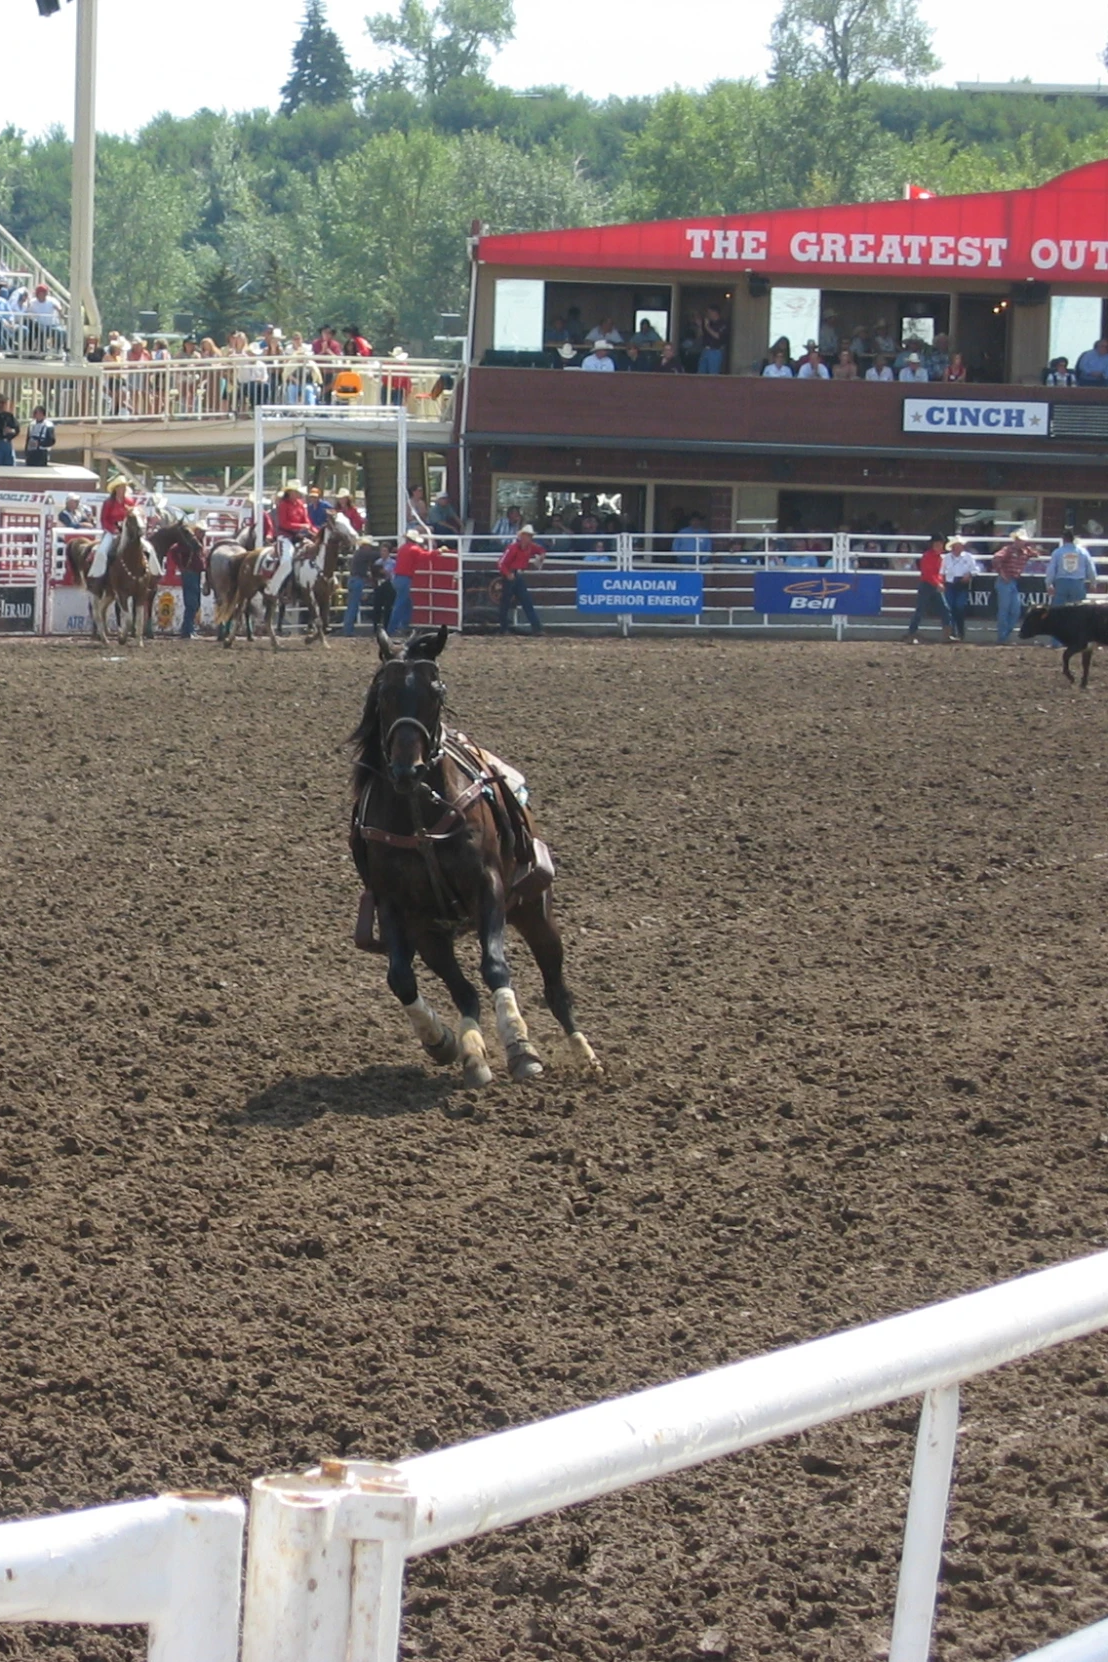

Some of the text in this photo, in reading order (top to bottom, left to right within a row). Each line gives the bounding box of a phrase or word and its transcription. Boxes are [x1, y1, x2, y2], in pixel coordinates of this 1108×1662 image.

[686, 229, 767, 260] THE
[790, 231, 1008, 267] GREATEST
[925, 406, 1025, 427] CINCH
[603, 579, 677, 591] CANADIAN
[579, 594, 699, 606] SUPERIOR ENERGY
[790, 597, 837, 609] Bell
